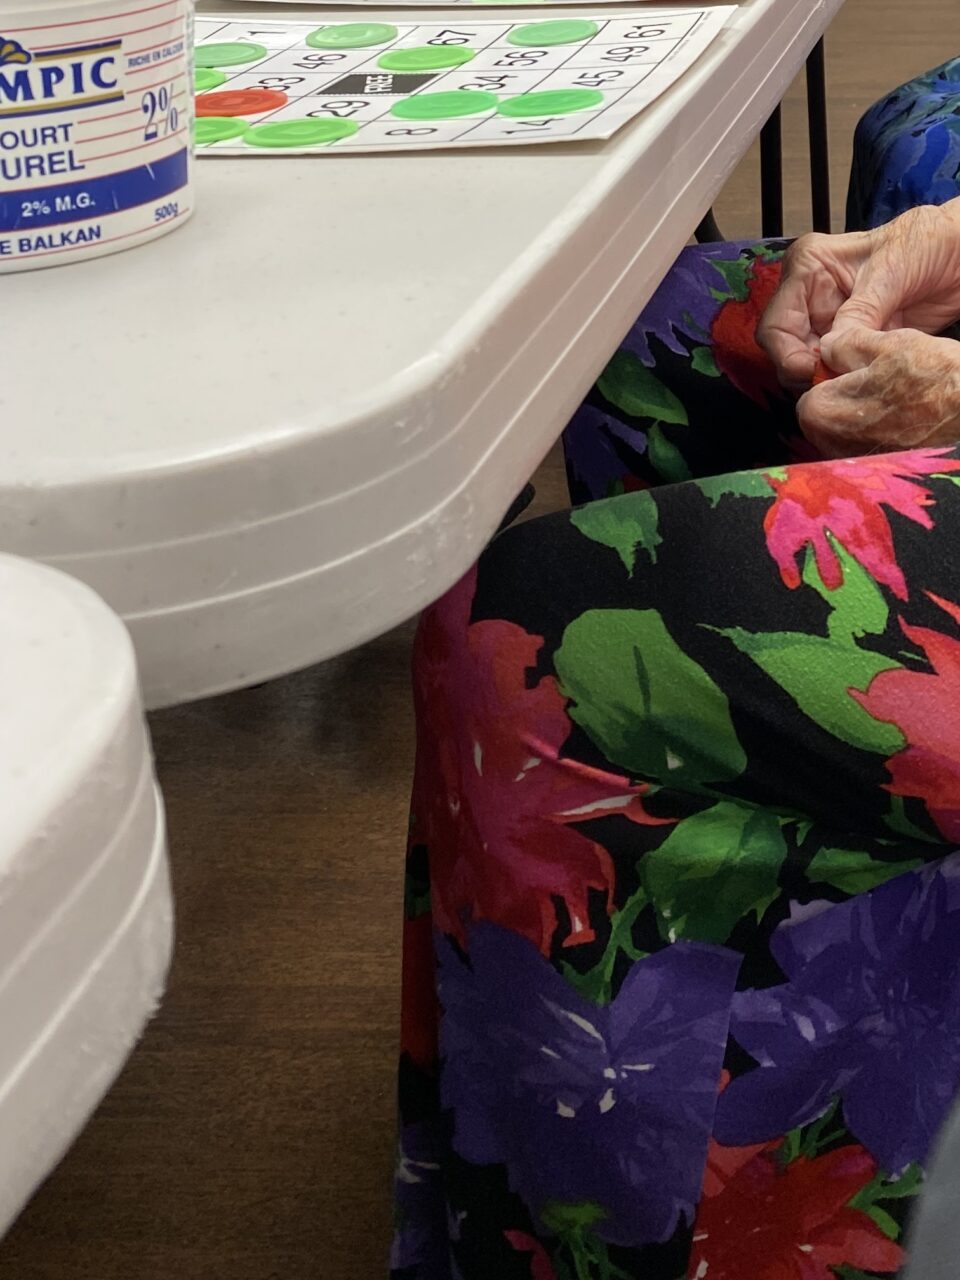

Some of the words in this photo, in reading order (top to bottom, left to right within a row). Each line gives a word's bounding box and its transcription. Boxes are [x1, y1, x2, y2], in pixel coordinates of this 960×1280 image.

[623, 22, 672, 39] 61
[293, 53, 347, 70] 46
[600, 45, 650, 63] 49
[306, 100, 371, 118] 29
[364, 73, 393, 93] FREE
[427, 29, 478, 46] 67
[572, 70, 625, 88] 45
[385, 127, 438, 136] 8
[458, 74, 518, 91] 34
[493, 50, 549, 67] 56
[141, 83, 179, 141] 2%
[0, 123, 73, 150] OURT
[21, 200, 50, 217] 2%
[55, 192, 96, 212] M.G.
[154, 202, 179, 221] 500g
[18, 225, 101, 253] BALKAN
